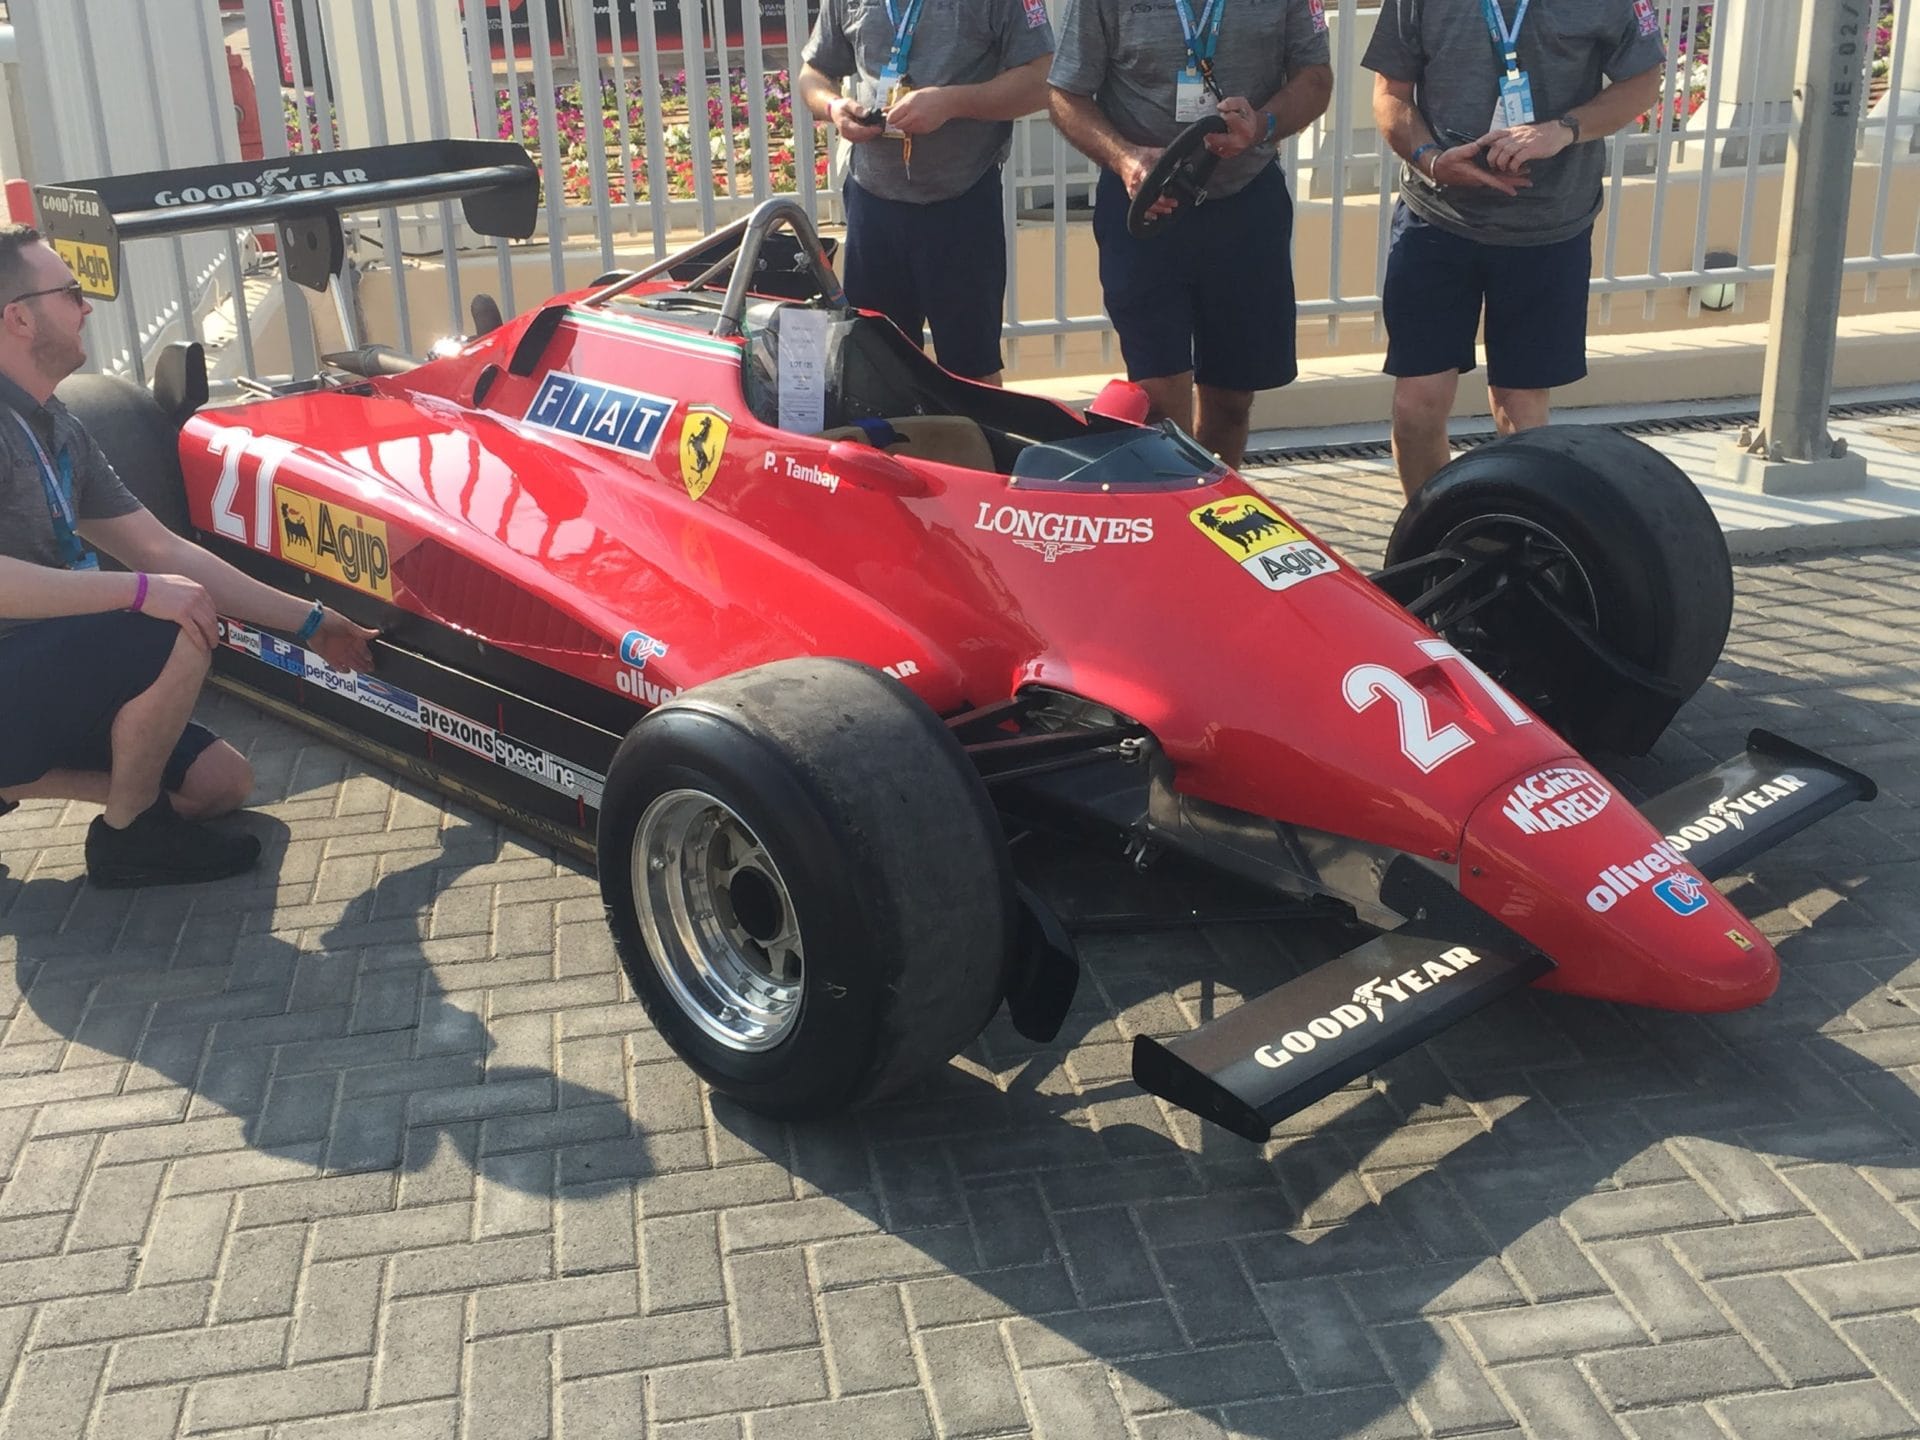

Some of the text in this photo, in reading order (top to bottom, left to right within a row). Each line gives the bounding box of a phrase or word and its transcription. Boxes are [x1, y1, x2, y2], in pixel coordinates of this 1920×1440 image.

[42, 194, 100, 218] GOODYEAR
[154, 167, 369, 207] GOODYEAR
[77, 246, 110, 288] Agip
[536, 384, 662, 443] FIAT
[207, 426, 303, 552] 27
[764, 451, 840, 494] P. Tambay
[316, 502, 389, 591] Agip
[974, 501, 1154, 545] LONGINES
[1258, 546, 1328, 583] Agip
[229, 629, 260, 650] CHAMPION
[305, 663, 357, 694] personal
[357, 694, 420, 724] pininfarina
[419, 703, 495, 754] arexons
[1341, 638, 1533, 775] 27
[495, 736, 577, 790] speedline
[1665, 774, 1808, 852] OODYEAR
[1586, 841, 1688, 913] olivett
[1254, 946, 1482, 1069] GOODYEAR
